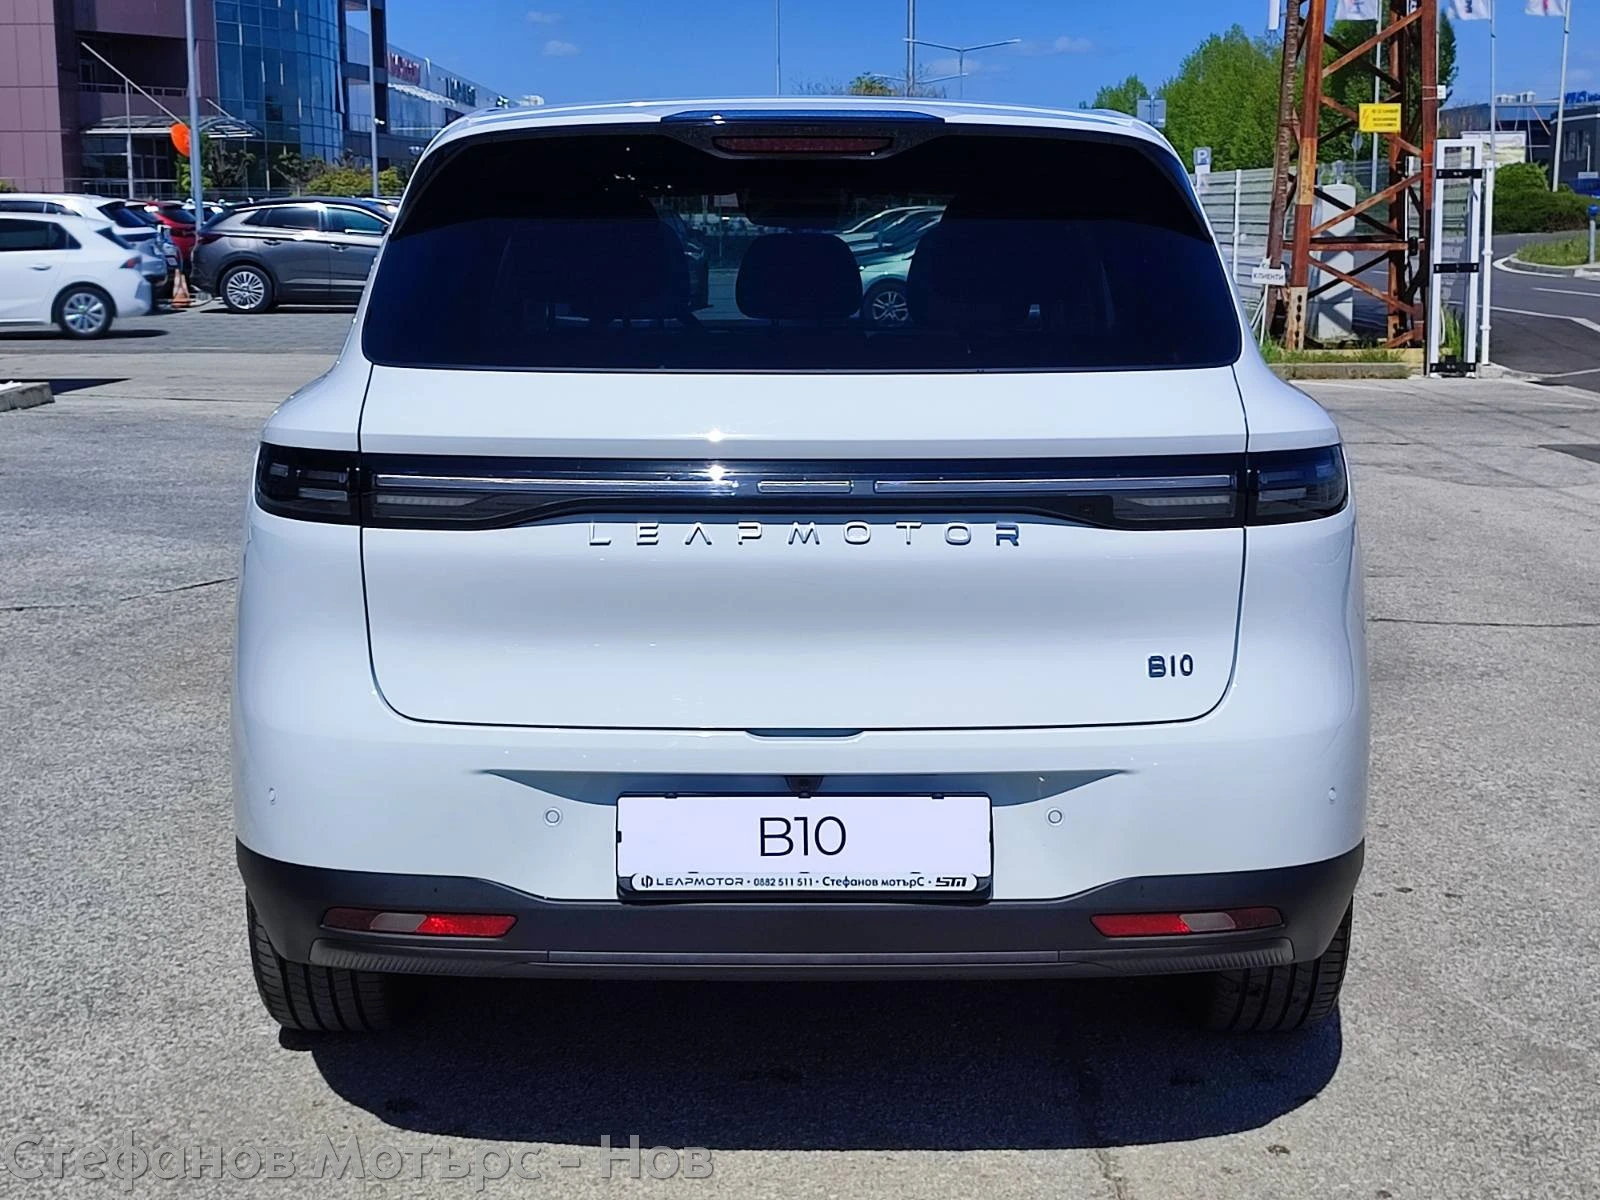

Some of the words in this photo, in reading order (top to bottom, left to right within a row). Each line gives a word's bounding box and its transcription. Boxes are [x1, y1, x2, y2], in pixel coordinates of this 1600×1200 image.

[1197, 149, 1208, 164] P
[589, 521, 1020, 547] LEAPMOTOR
[1148, 654, 1193, 678] B10
[760, 815, 847, 856] B10
[656, 877, 744, 887] LEAPMOTOR
[753, 877, 776, 887] 0882
[778, 877, 794, 887] 511
[797, 877, 813, 887] 511
[822, 876, 879, 889] Стефанов
